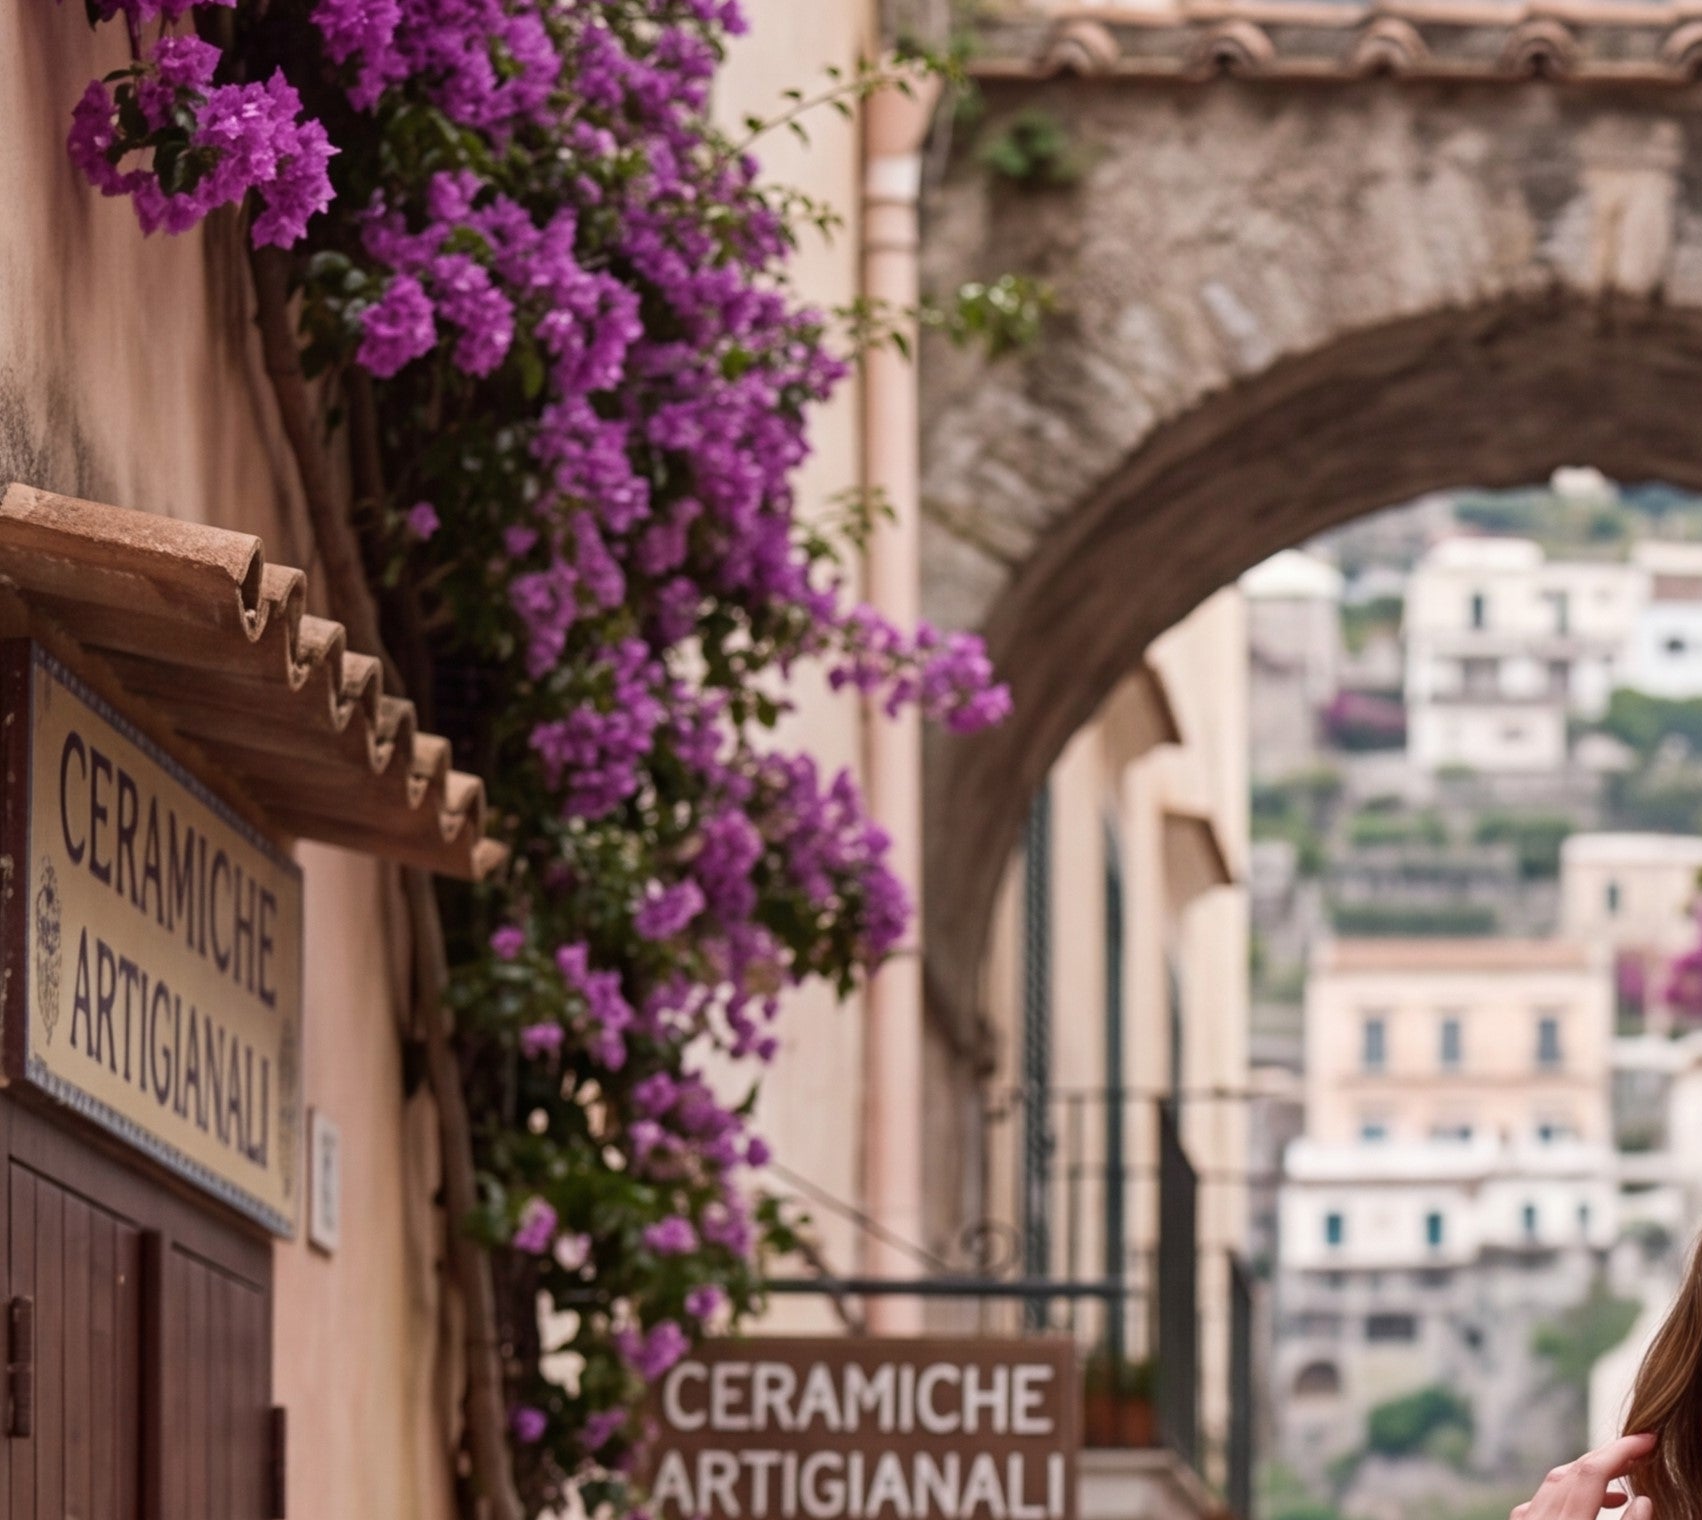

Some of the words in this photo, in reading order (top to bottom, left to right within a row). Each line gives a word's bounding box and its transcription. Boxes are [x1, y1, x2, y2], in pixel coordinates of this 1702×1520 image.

[59, 730, 277, 1009] CERAMICHE
[69, 925, 271, 1170] ARTIGIANALI
[662, 1360, 1055, 1435] CERAMICHE
